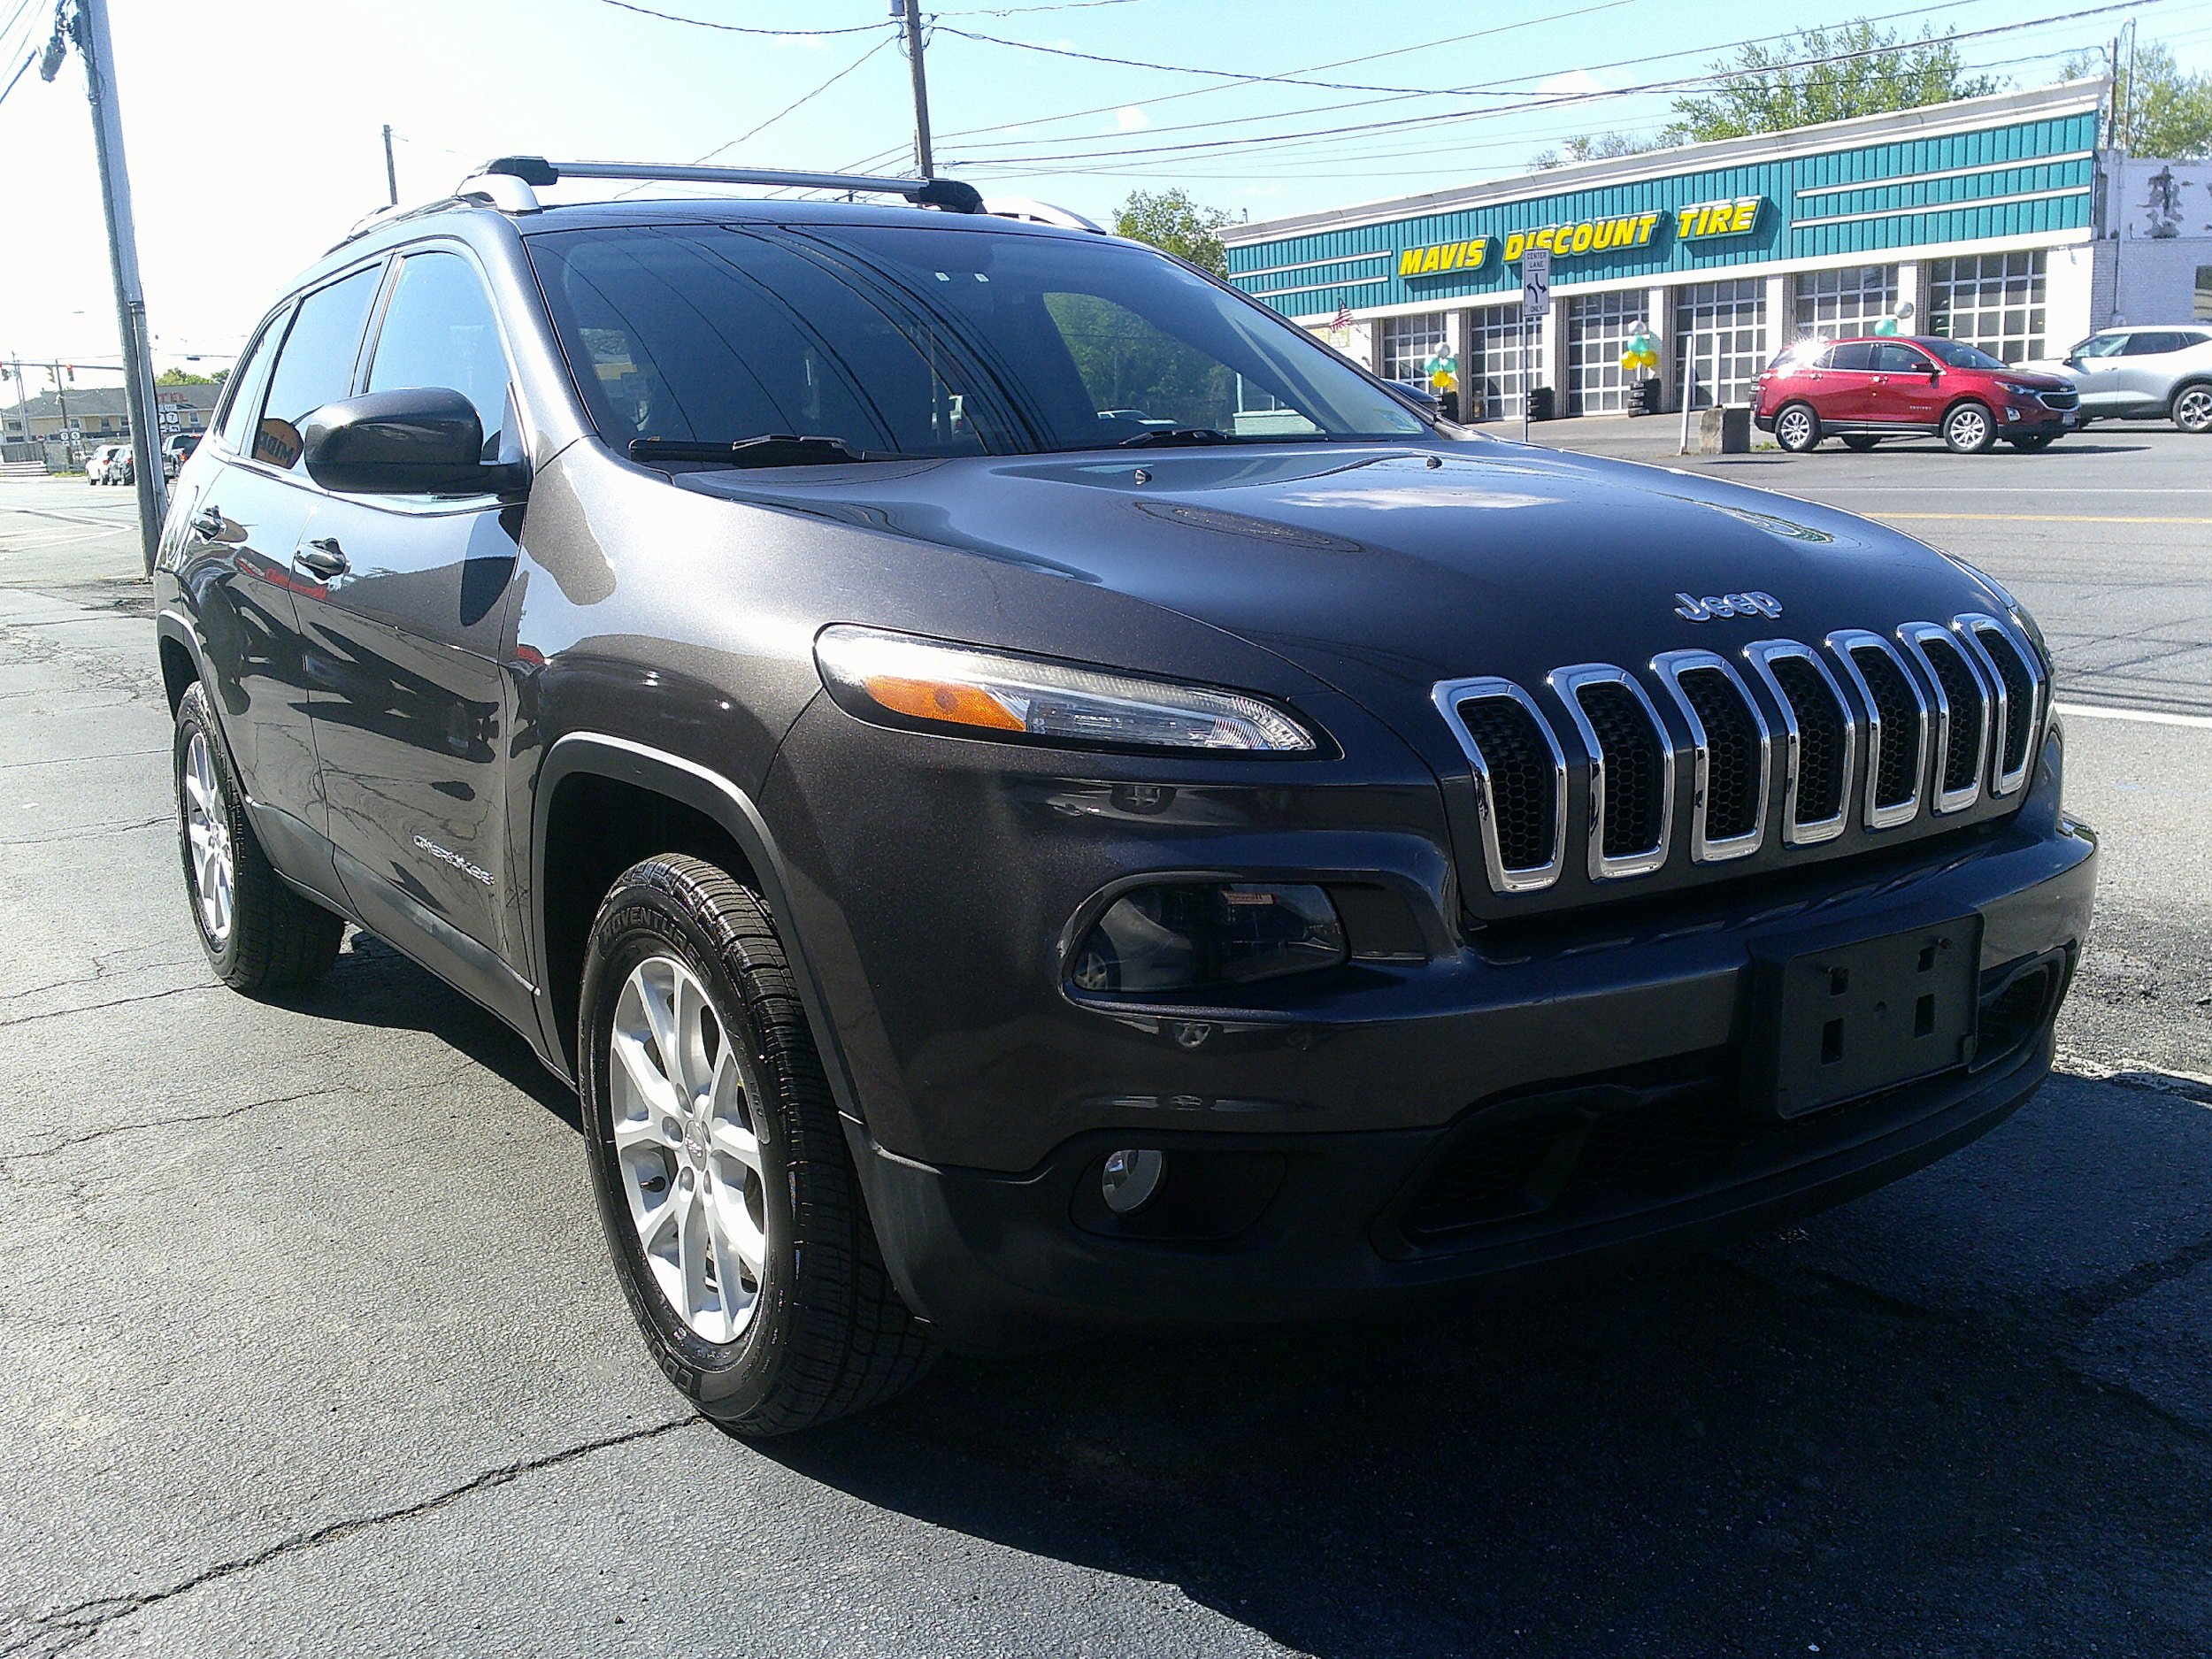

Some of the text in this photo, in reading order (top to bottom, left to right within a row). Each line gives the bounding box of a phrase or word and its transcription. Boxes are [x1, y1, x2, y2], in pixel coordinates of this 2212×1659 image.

[1399, 201, 1758, 276] MAVIS DISCOUNT TIRE
[1527, 251, 1547, 260] CENTER
[157, 392, 188, 403] TEL
[1674, 591, 1783, 621] Jeep
